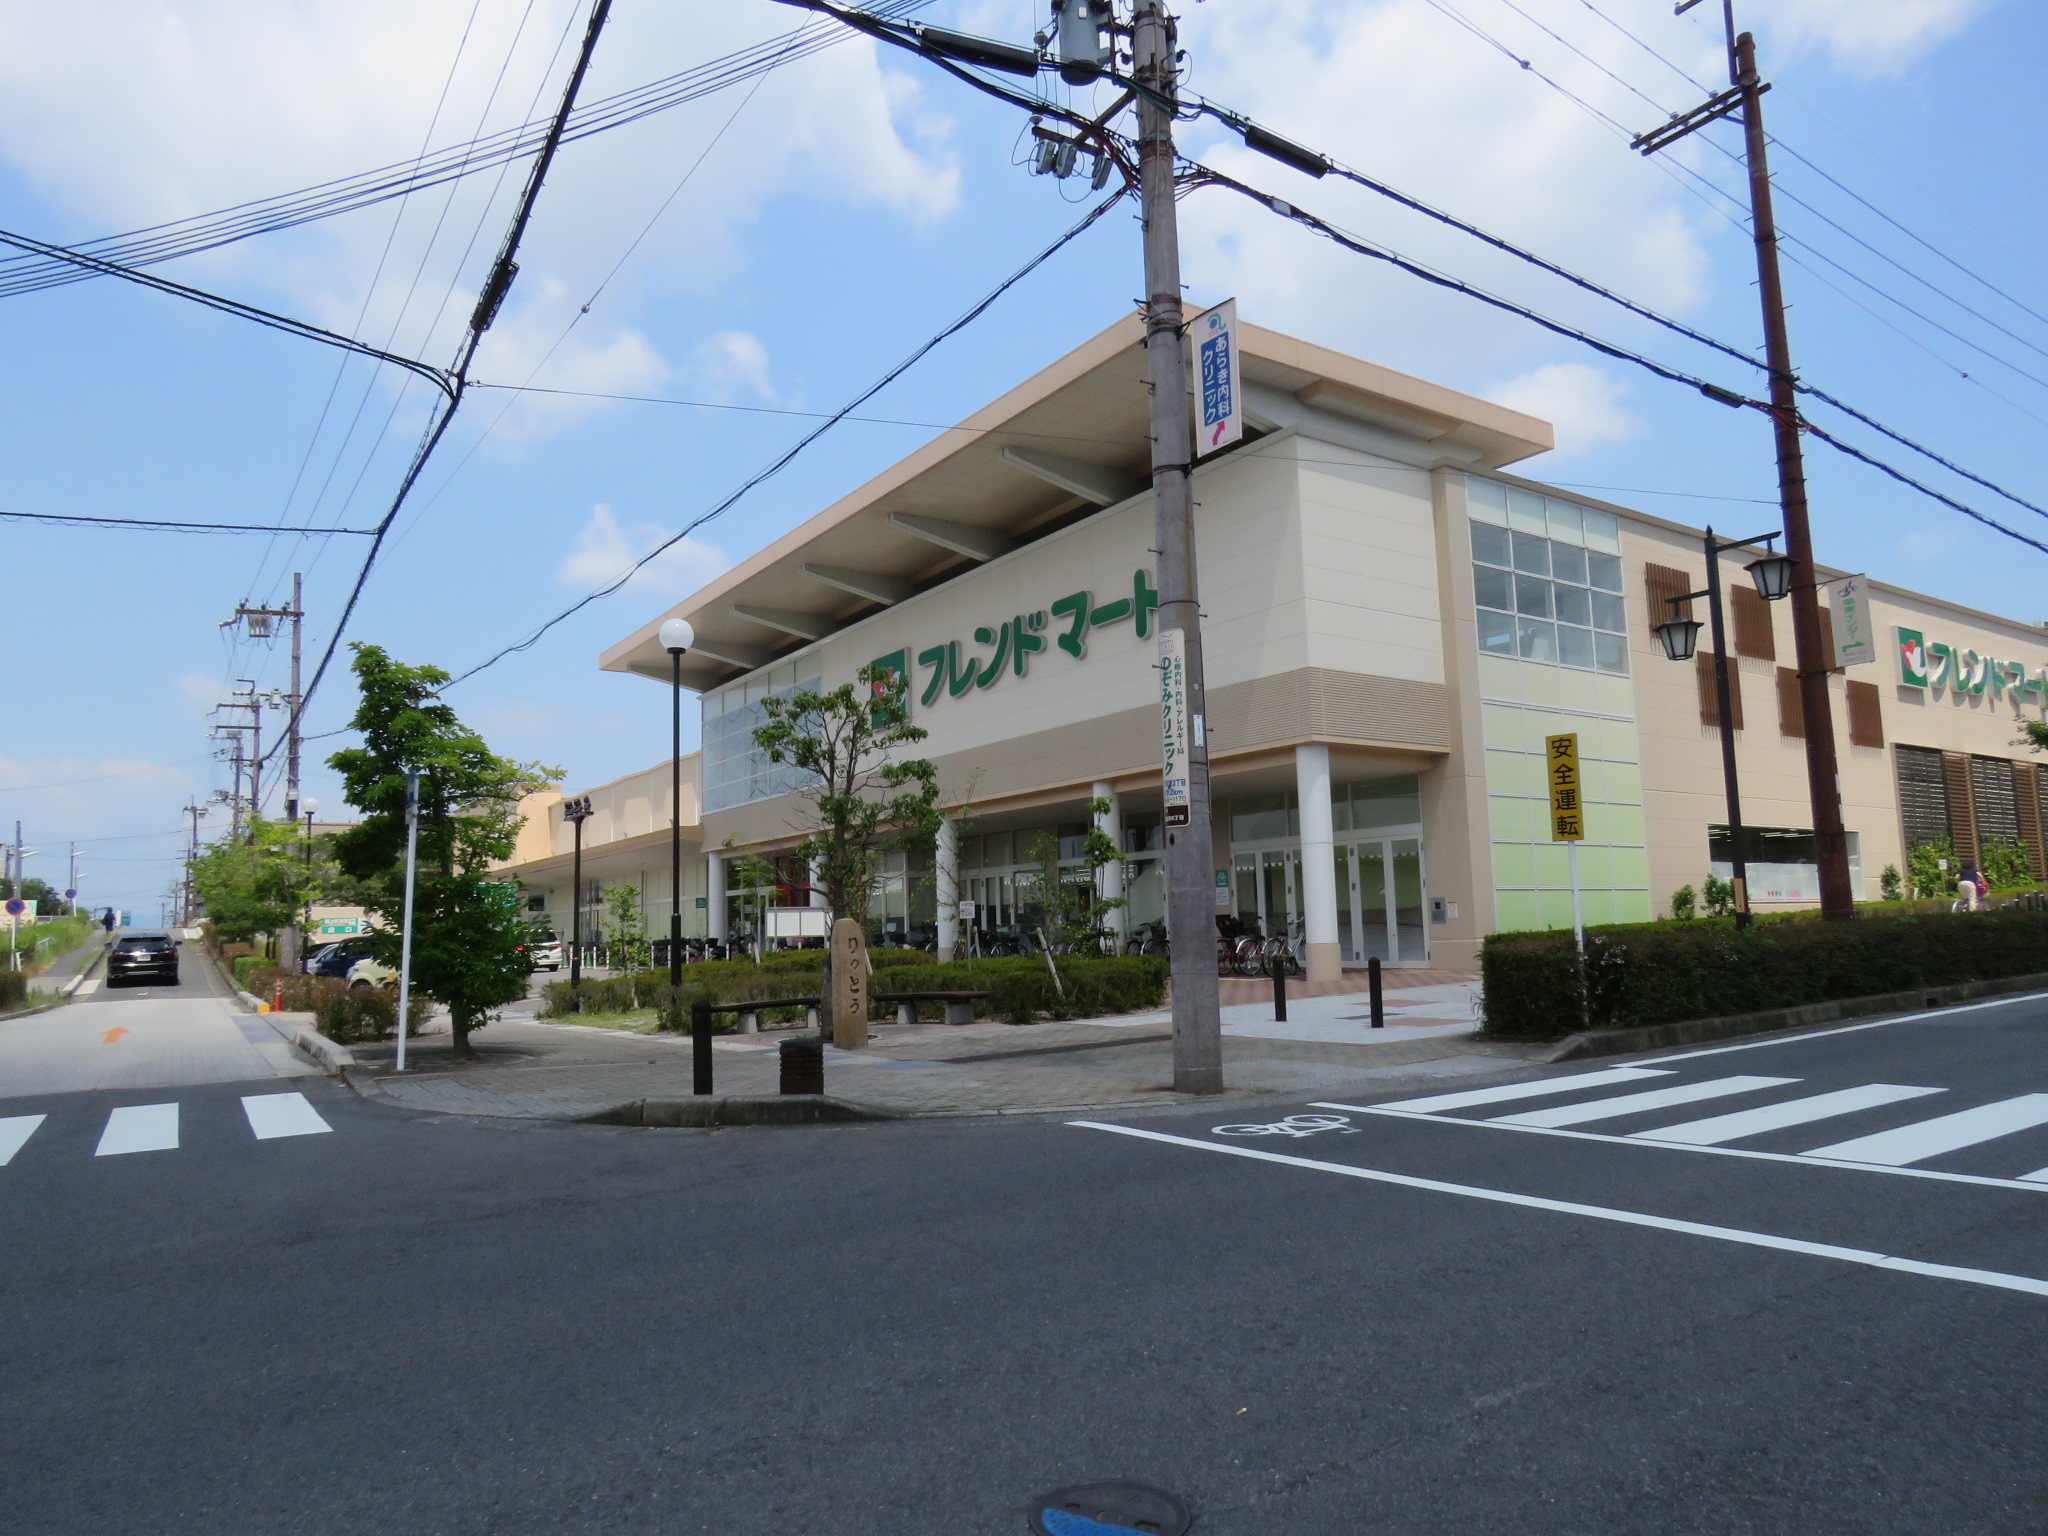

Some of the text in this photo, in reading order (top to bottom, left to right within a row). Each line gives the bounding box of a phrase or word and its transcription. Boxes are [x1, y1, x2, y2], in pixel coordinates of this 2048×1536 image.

[1203, 351, 1216, 424] クリニック
[1216, 336, 1230, 417] あらき内科
[1161, 656, 1175, 776] のぞみクリニック
[1552, 737, 1579, 837] 安全運転
[848, 937, 860, 1014] りっとう
